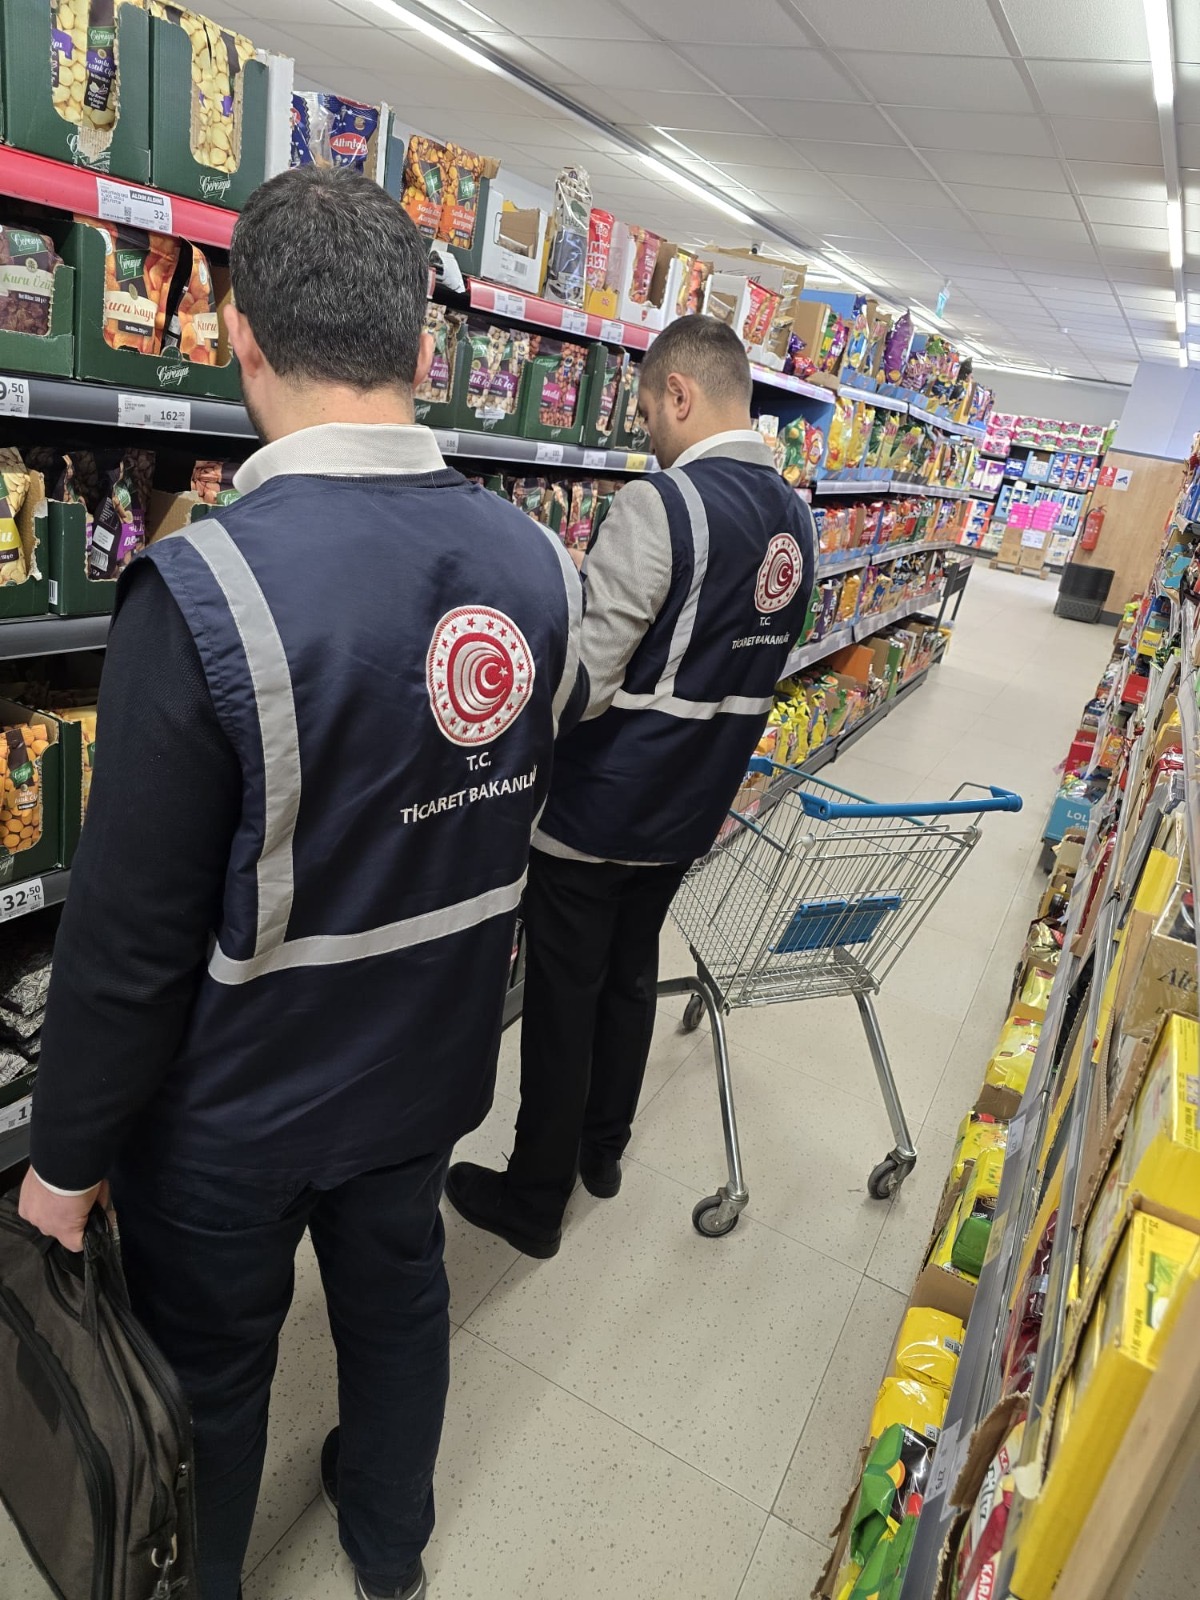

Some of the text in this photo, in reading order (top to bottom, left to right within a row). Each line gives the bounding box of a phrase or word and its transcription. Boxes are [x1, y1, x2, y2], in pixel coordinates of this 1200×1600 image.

[51, 40, 63, 48] ips
[3, 272, 51, 290] Kuru Üzü
[157, 365, 190, 387] Cerezya
[16, 395, 24, 403] TL
[160, 411, 178, 421] 162
[400, 789, 467, 824] TİCARET
[33, 894, 41, 902] TL
